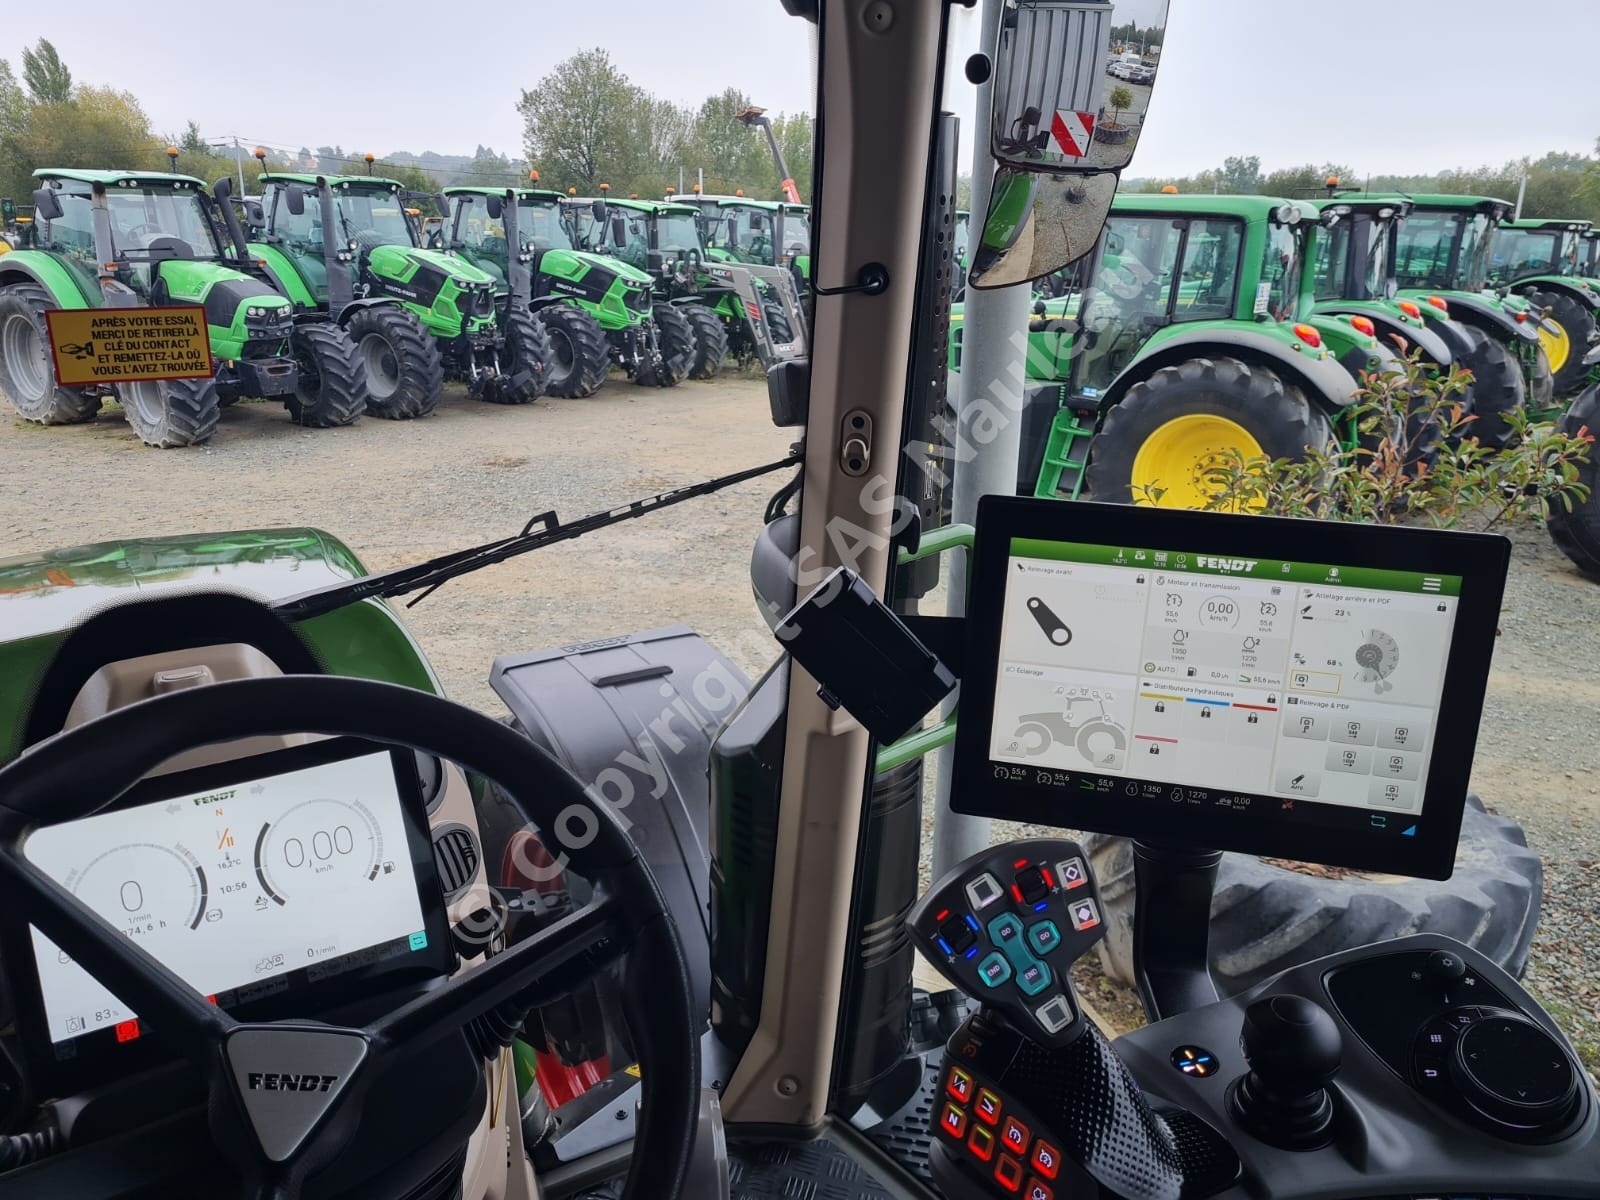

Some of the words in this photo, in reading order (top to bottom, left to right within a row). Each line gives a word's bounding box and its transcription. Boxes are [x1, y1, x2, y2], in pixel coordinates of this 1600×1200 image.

[92, 316, 126, 328] APRÈS
[128, 317, 164, 327] VOTRE
[165, 316, 197, 326] ESSAI,
[92, 330, 125, 339] MERCI
[128, 329, 141, 338] DE
[143, 328, 184, 338] RETIRER
[187, 327, 199, 336] LA
[104, 340, 124, 351] CLÉ
[126, 341, 140, 350] DU
[143, 339, 190, 350] CONTACT
[98, 354, 110, 363] ET
[114, 350, 184, 363] REMETTEZ-LA
[186, 349, 200, 360] OÙ
[92, 366, 121, 375] VOUS
[123, 364, 158, 374] L'AVEZ
[161, 361, 209, 372] TROUVÉE.
[1197, 556, 1257, 571] FENDT
[1167, 579, 1190, 587] Moteur
[1199, 581, 1240, 591] transmission
[1315, 592, 1344, 602] Attelage
[1207, 602, 1234, 614] 0,00
[1172, 647, 1187, 655] 1350
[1154, 683, 1193, 693] Distributeurs
[1011, 767, 1027, 776] 55,6
[1054, 773, 1070, 782] 55,6
[1098, 779, 1114, 788] 55,6
[1143, 784, 1162, 793] 1350
[193, 790, 237, 806] FENDT
[1189, 790, 1207, 799] 1270
[1234, 796, 1251, 805] 0,00
[216, 808, 223, 816] N
[284, 825, 354, 868] 0,00
[315, 864, 335, 874] km/h
[220, 881, 247, 895] 10:56
[120, 880, 143, 912] 0
[128, 913, 152, 925] 1/min
[1001, 927, 1011, 937] GO
[1040, 931, 1050, 941] GO
[1024, 967, 1038, 980] END
[95, 1009, 112, 1022] 83
[248, 1072, 338, 1092] FENDT
[948, 1112, 958, 1127] N
